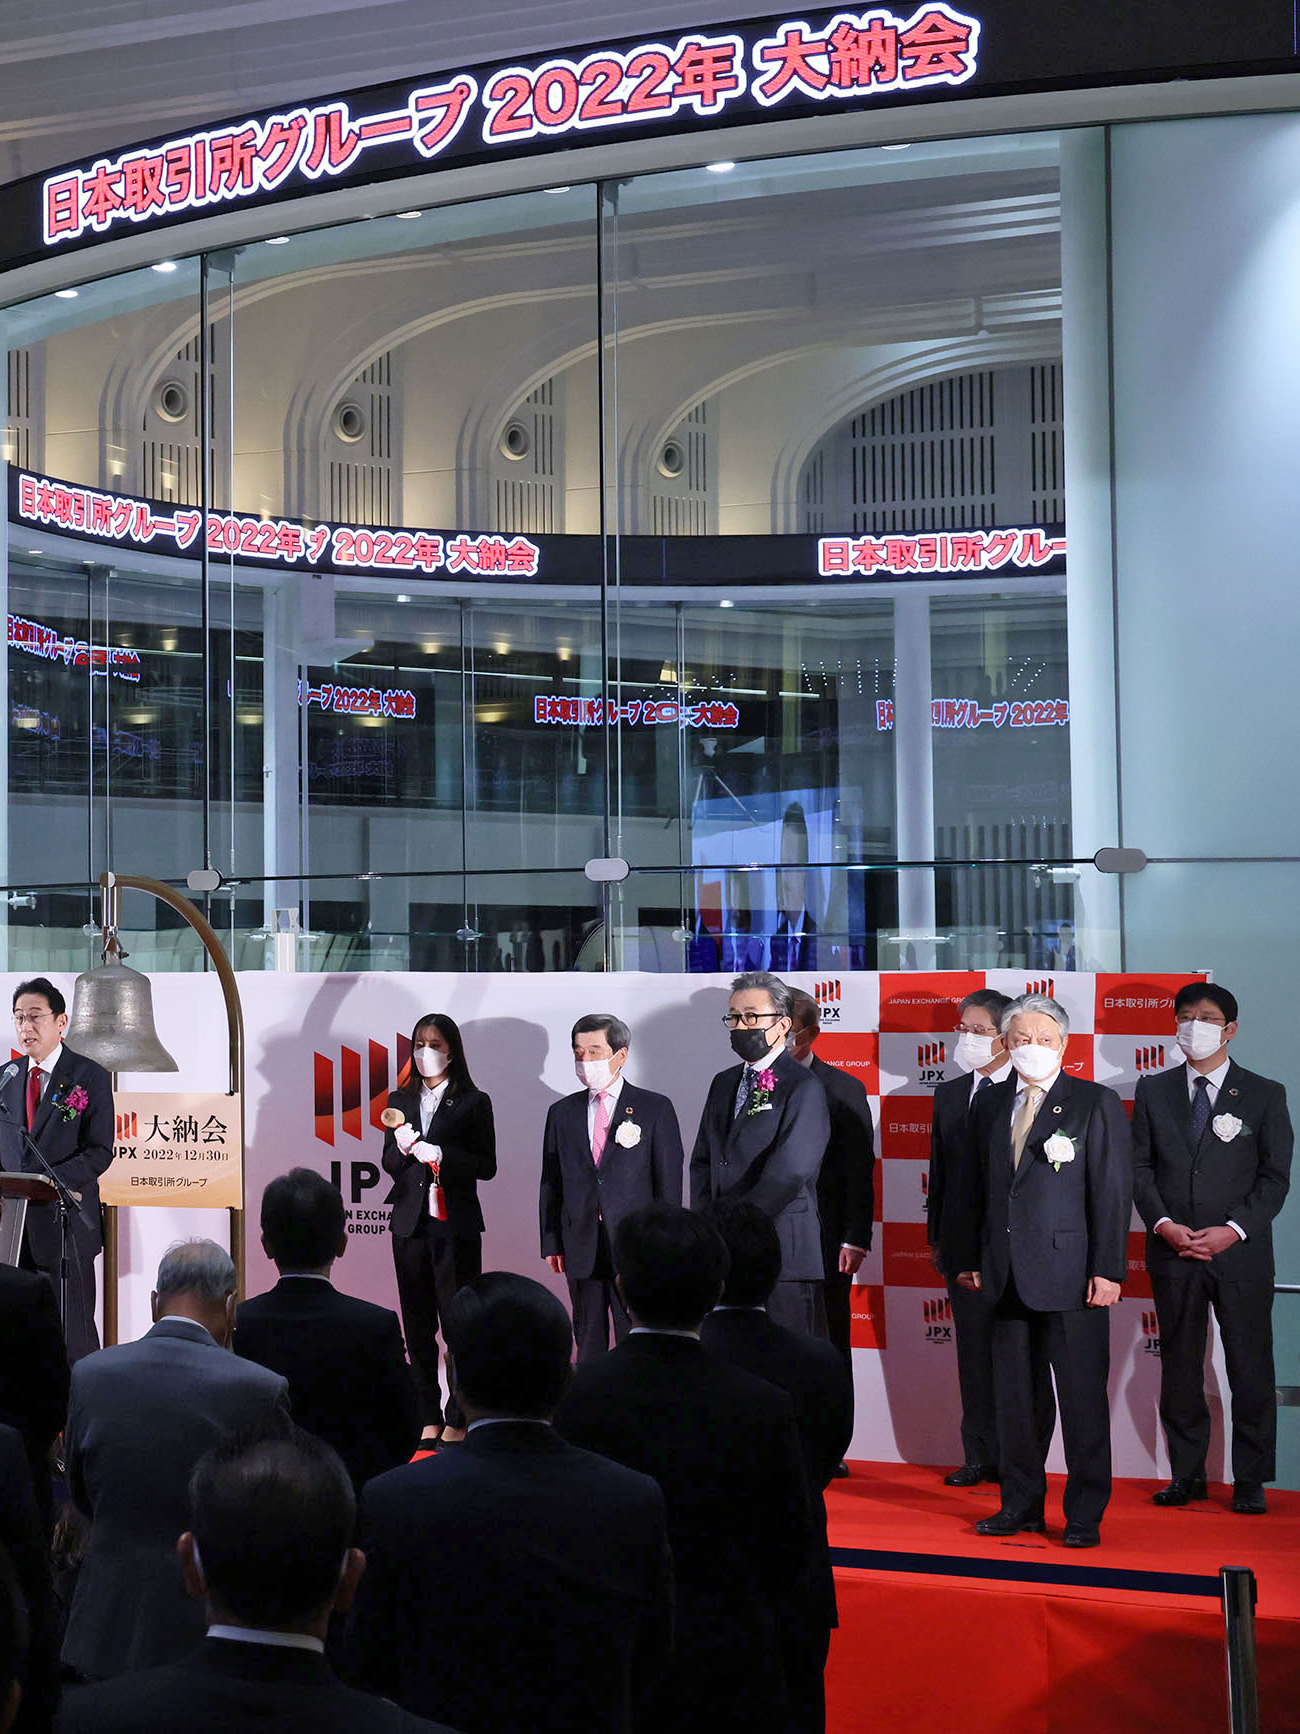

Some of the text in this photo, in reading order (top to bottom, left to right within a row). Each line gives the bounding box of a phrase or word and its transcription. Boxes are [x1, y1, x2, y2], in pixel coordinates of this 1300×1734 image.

[45, 7, 976, 240] 日本取引所グループ 2022年 大納会
[20, 476, 303, 560] 日本取引所グループ 2022年
[334, 530, 442, 570] 2022年
[448, 538, 537, 574] 大納会
[1010, 700, 1069, 726] 2022年
[919, 1070, 945, 1081] JPX
[144, 1115, 227, 1144] 大納会
[113, 1147, 137, 1159] JPX
[143, 1149, 229, 1161] 2022年12月30日
[131, 1177, 207, 1187] 日本取引所グループ
[356, 1210, 391, 1220] EXCHA
[348, 1224, 386, 1234] GROUP
[926, 1327, 951, 1338] JPX
